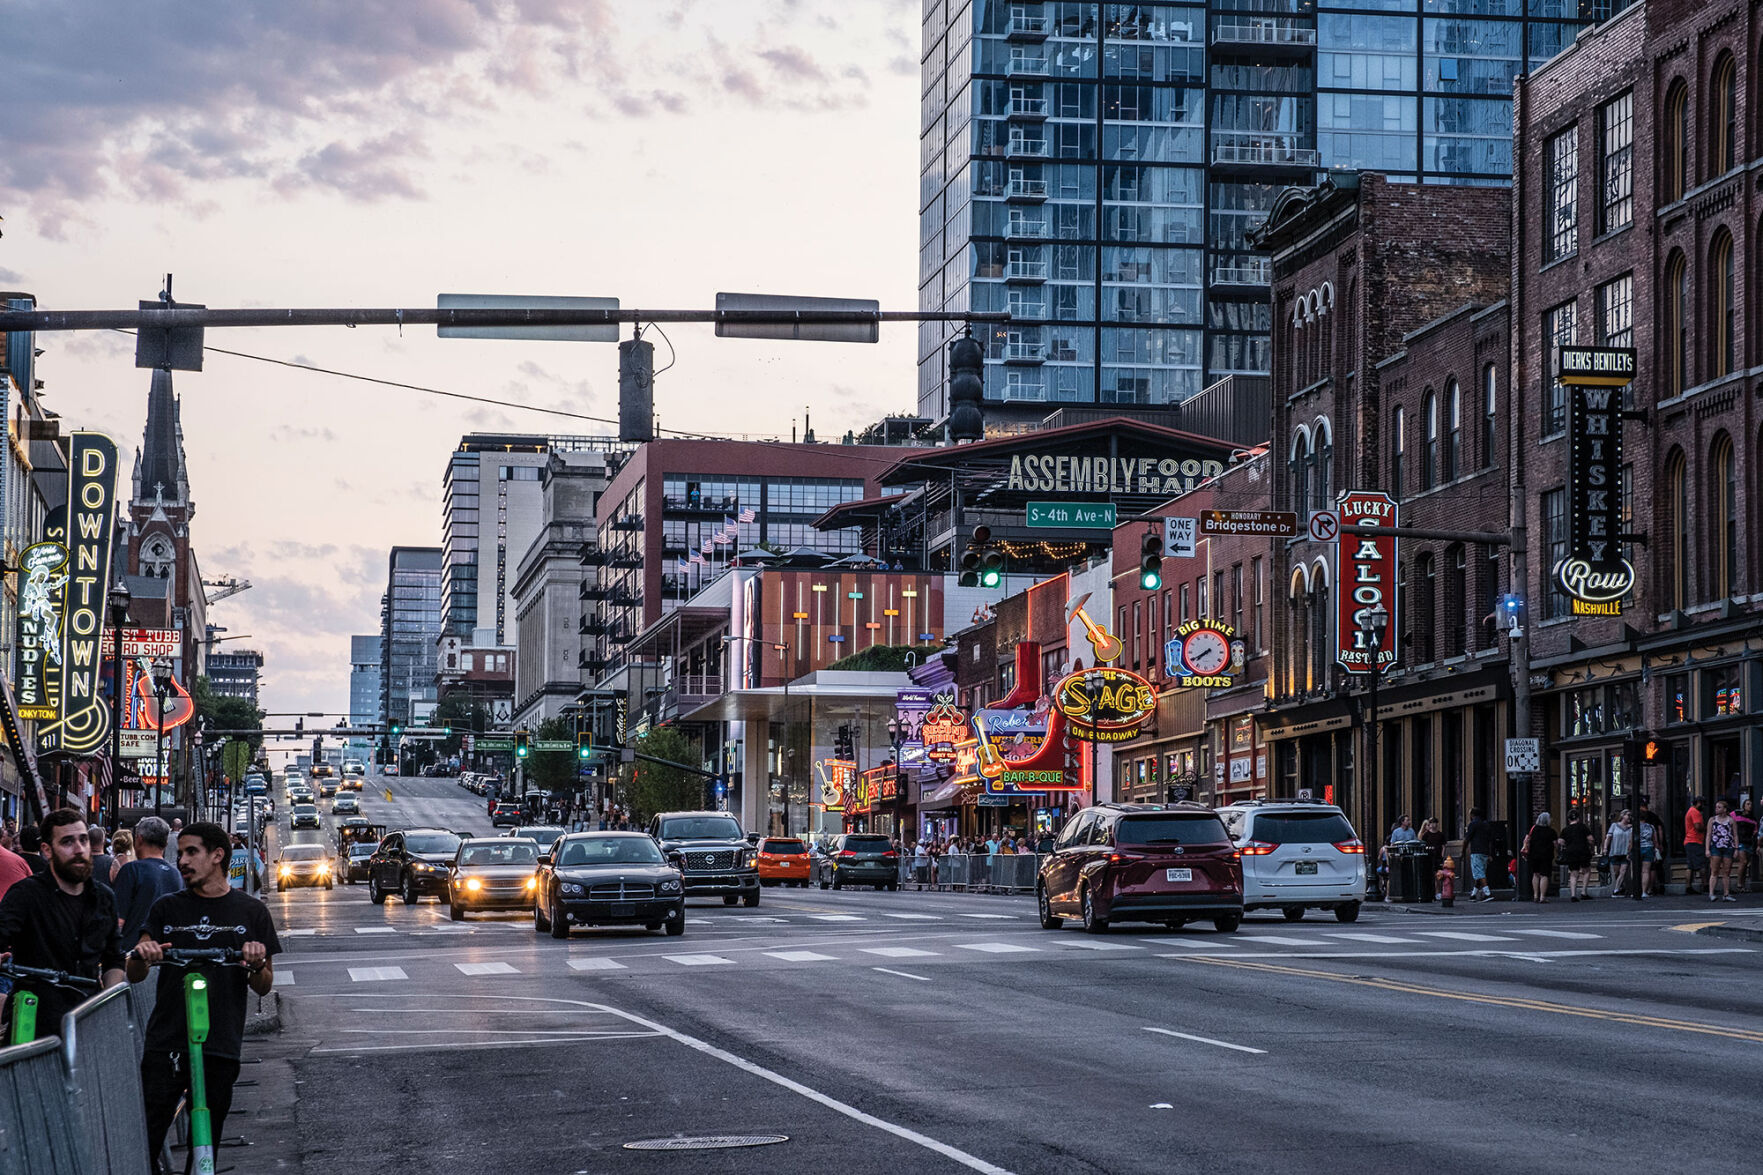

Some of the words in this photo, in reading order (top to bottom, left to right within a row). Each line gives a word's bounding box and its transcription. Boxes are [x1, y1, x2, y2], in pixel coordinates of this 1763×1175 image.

[1563, 351, 1592, 370] DIERKS
[1008, 455, 1136, 492] ASSEMBLY
[1138, 458, 1223, 477] FOOD
[1583, 388, 1612, 562] WHISKEY
[1342, 501, 1392, 517] LUCKY
[1169, 519, 1191, 530] ONE
[1231, 513, 1261, 521] HONORARY
[1205, 519, 1277, 533] Bridgestone
[1279, 524, 1291, 533] Dr
[1169, 530, 1192, 541] WAY
[72, 449, 105, 698] DOWNTOWN
[1568, 561, 1628, 598] Row
[1573, 599, 1621, 615] NASHVILLE
[1178, 620, 1200, 636] BIG
[1202, 619, 1235, 637] TIME
[146, 630, 180, 642] TUBB
[102, 643, 138, 655] ECRD
[143, 644, 173, 656] SHOP
[1340, 649, 1393, 664] BASTRD
[21, 621, 38, 704] NUDIES
[1182, 676, 1232, 687] BOOTS
[1063, 676, 1155, 716] SAGE
[38, 709, 57, 719] TONK
[922, 724, 967, 737] SECOND
[1073, 726, 1085, 738] ON
[1089, 728, 1139, 741] BOADWAY
[41, 734, 56, 749] 411
[990, 735, 1045, 744] WERN
[1508, 755, 1520, 768] OK
[123, 775, 140, 783] Beer
[1003, 771, 1062, 783] BAR-B-QUE
